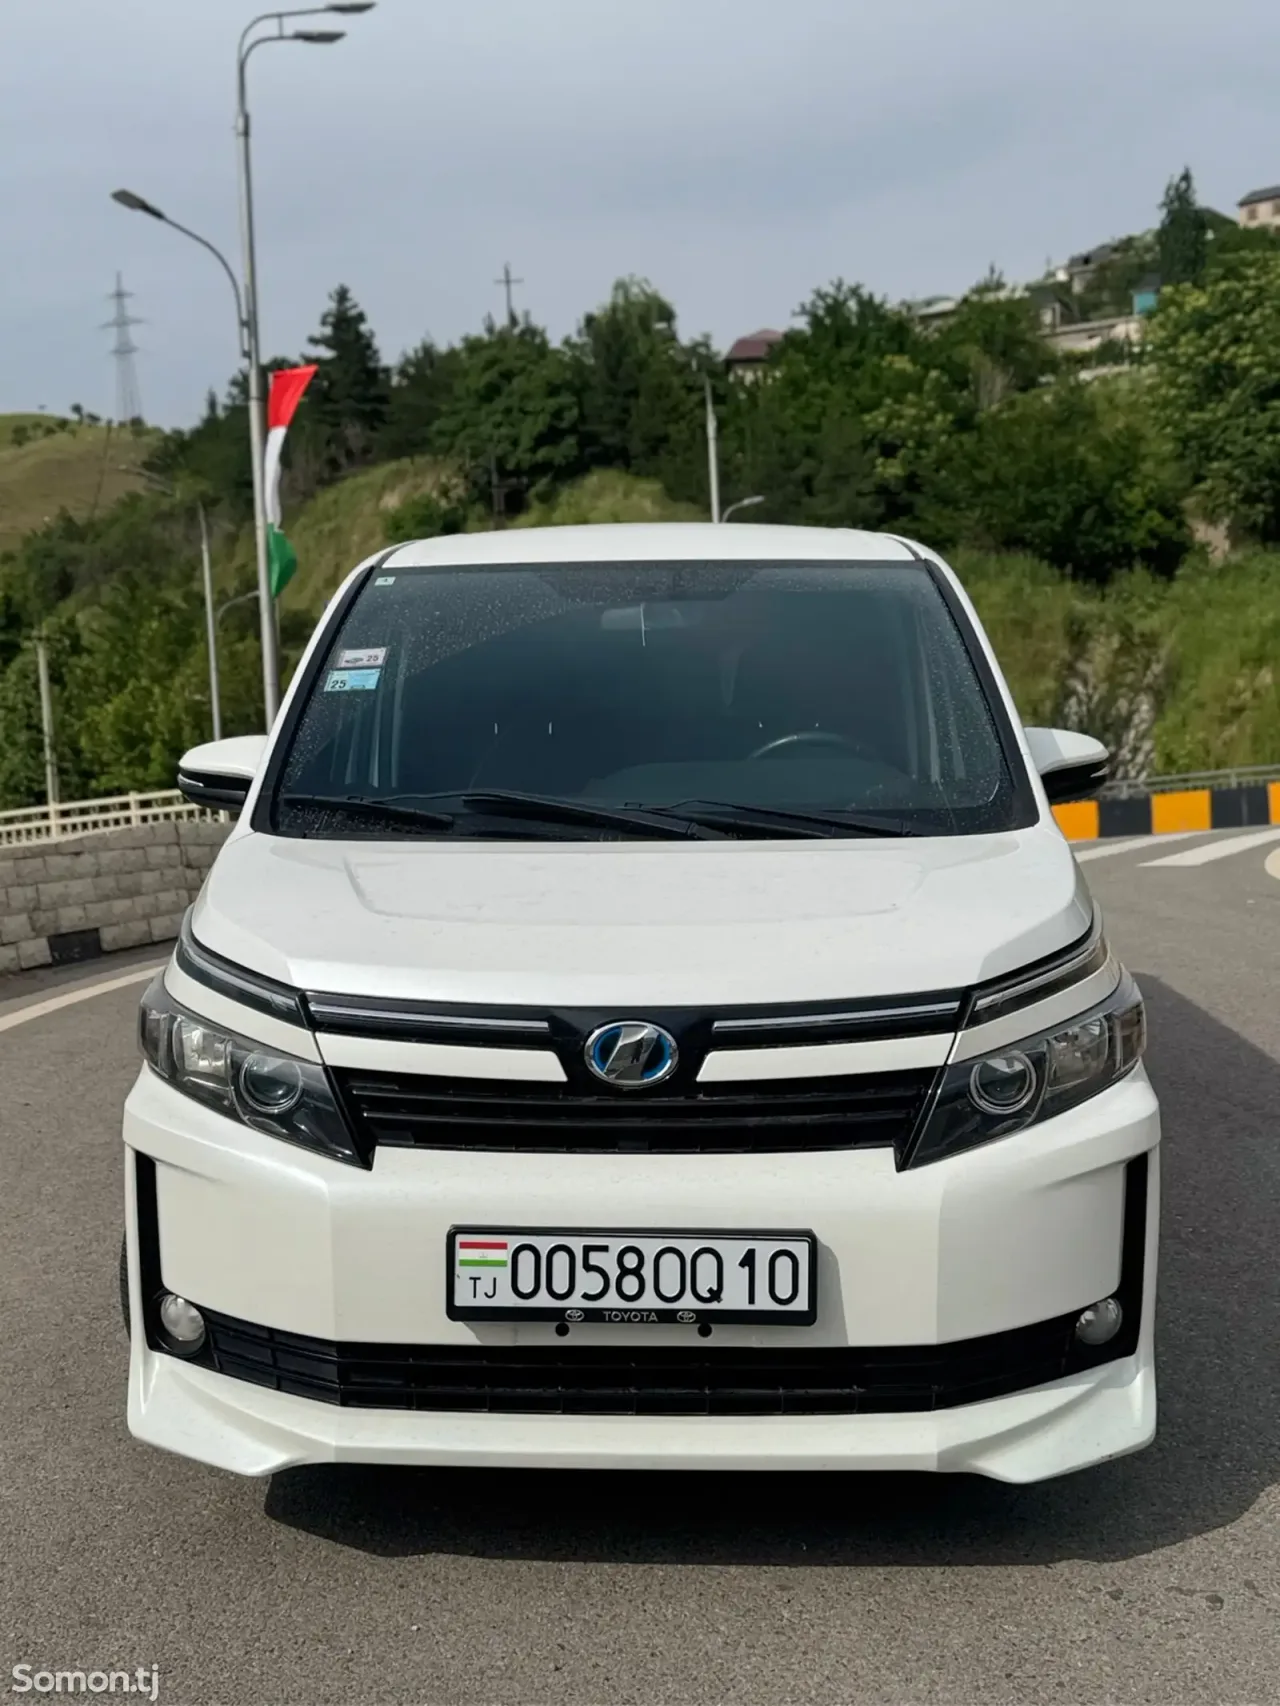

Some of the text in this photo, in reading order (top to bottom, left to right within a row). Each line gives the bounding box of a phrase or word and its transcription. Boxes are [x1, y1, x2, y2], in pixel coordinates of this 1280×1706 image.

[330, 680, 346, 689] 25
[469, 1276, 497, 1299] TJ
[602, 1311, 658, 1322] TOYOTA
